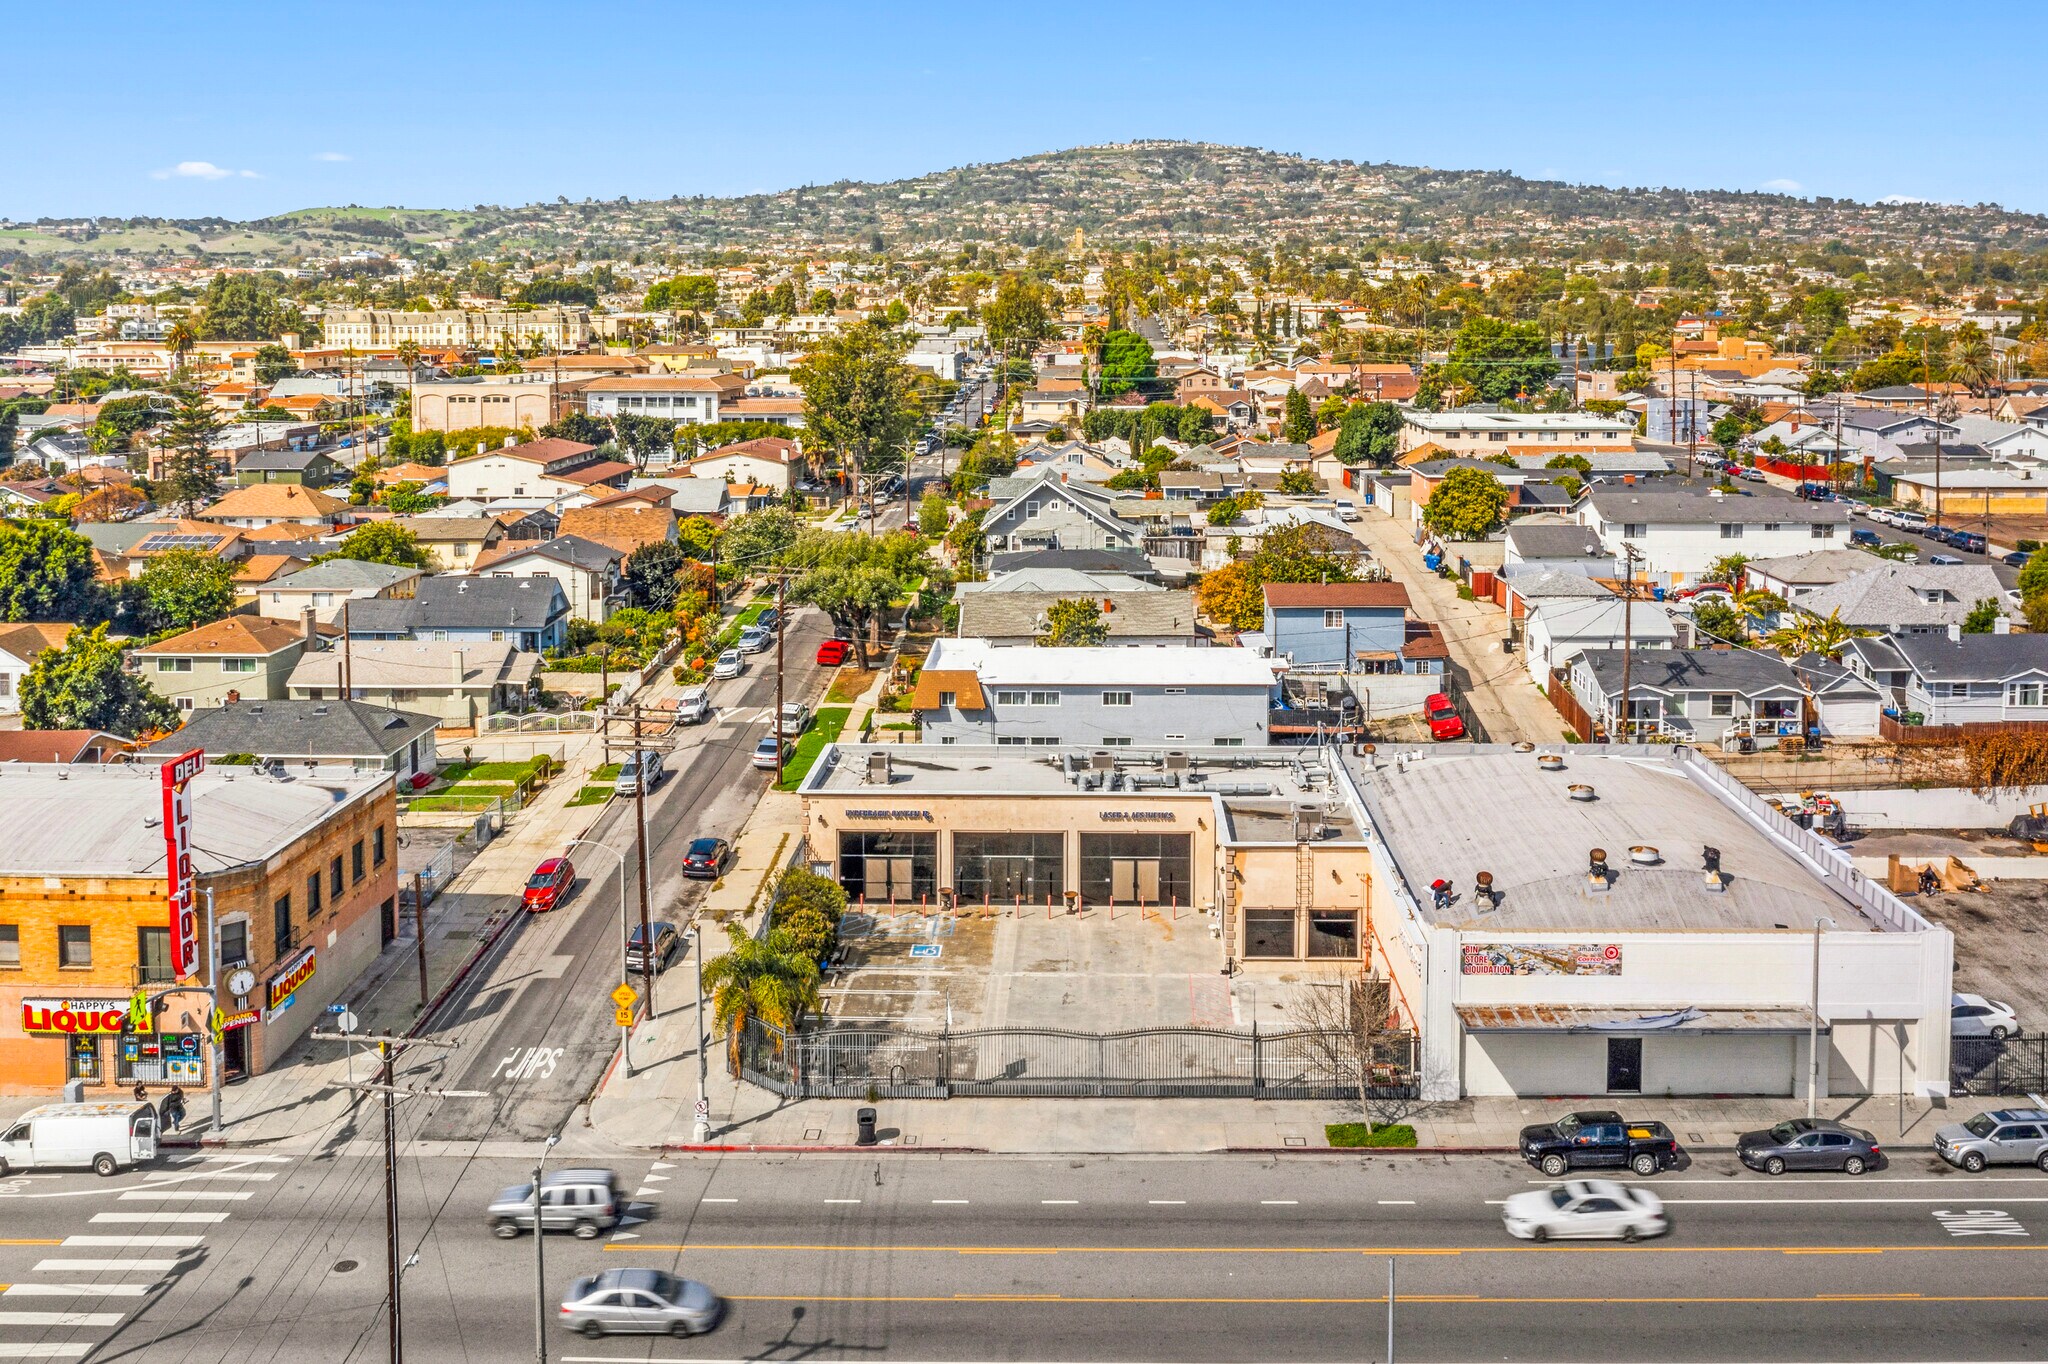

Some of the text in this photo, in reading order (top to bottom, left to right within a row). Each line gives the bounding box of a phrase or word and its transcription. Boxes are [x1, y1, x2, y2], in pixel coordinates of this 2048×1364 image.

[175, 754, 204, 783] DELI
[176, 799, 194, 968] LIQUOR
[1465, 946, 1478, 954] BIN
[1465, 955, 1488, 964] STORE
[1464, 965, 1510, 974] LIQUIDATION
[273, 954, 314, 1004] LIQUOR
[70, 1001, 115, 1010] HAPPY'S
[23, 1003, 149, 1033] LIQUO
[620, 1011, 629, 1019] 15
